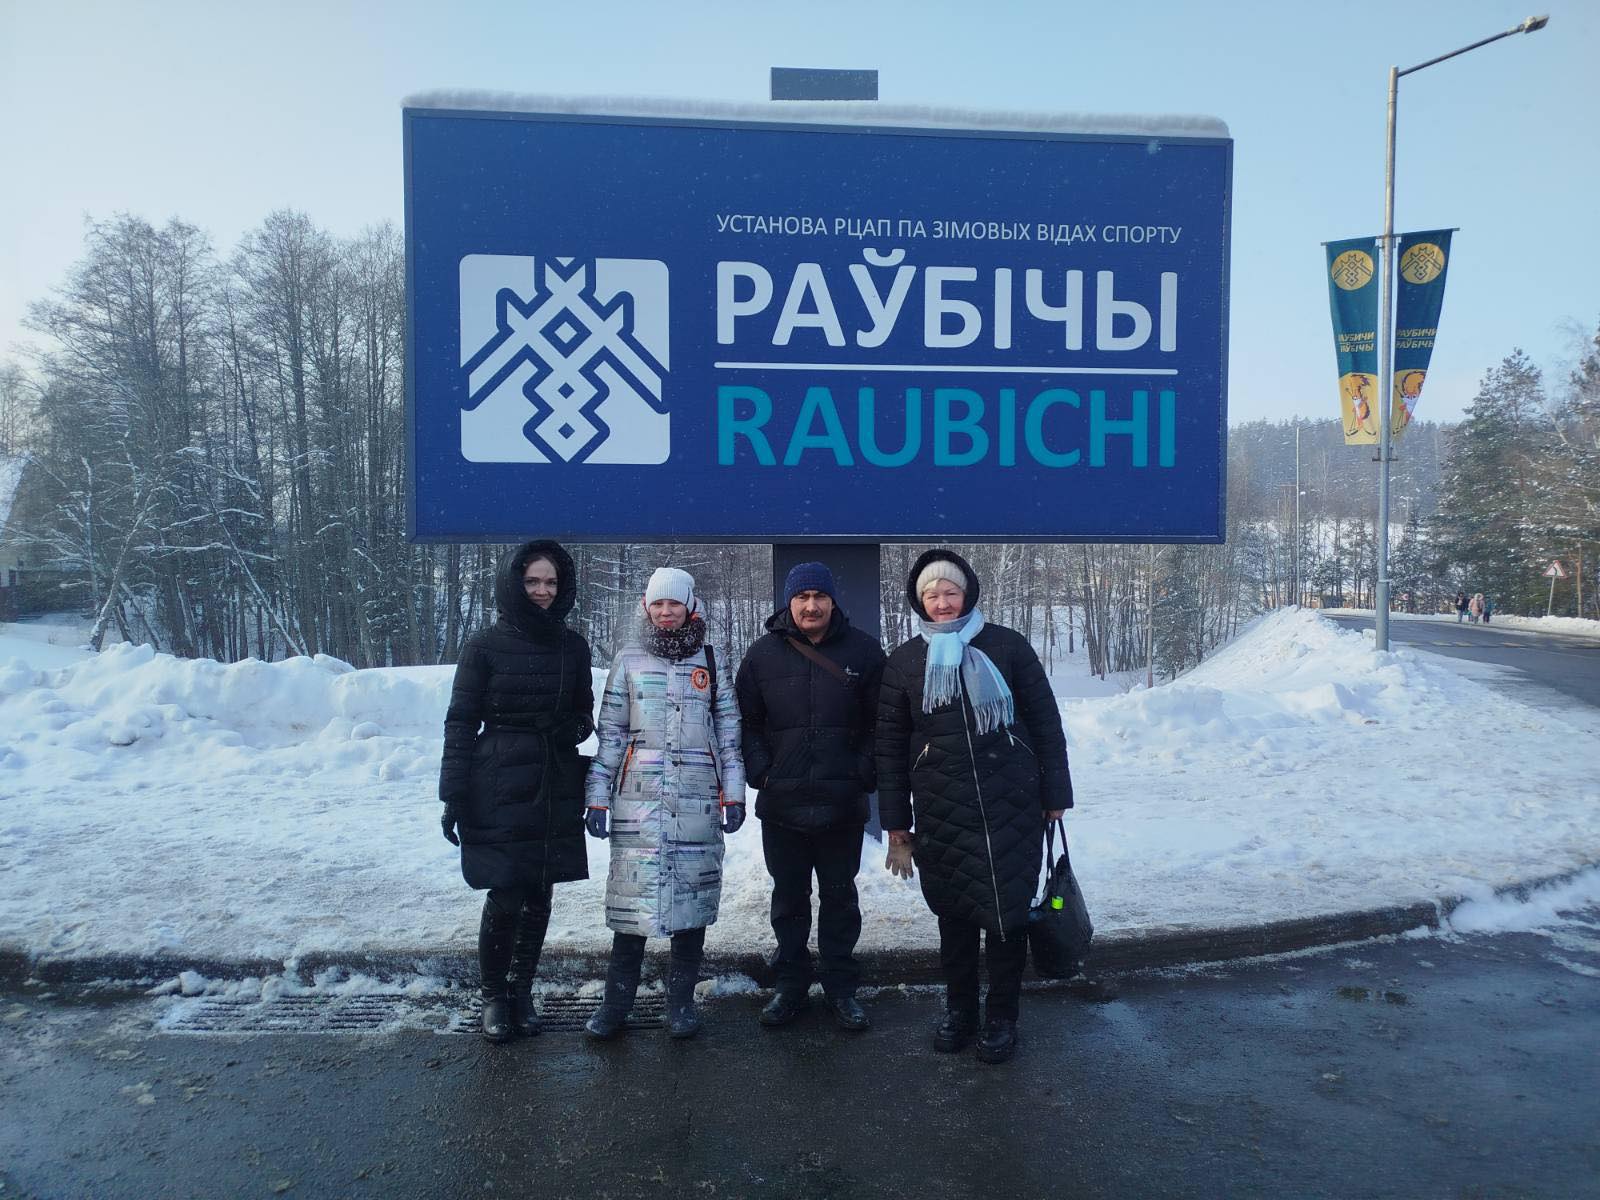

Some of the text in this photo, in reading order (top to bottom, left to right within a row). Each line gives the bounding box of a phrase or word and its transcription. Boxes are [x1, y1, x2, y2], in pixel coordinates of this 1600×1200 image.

[717, 214, 1182, 246] УСТАНОВА РЦАП ПА ЗІМОВЫХ ВІДАХ СПОРТУ
[716, 248, 1178, 352] РАЎБІЧЫ
[718, 387, 1176, 467] RAUBICHI
